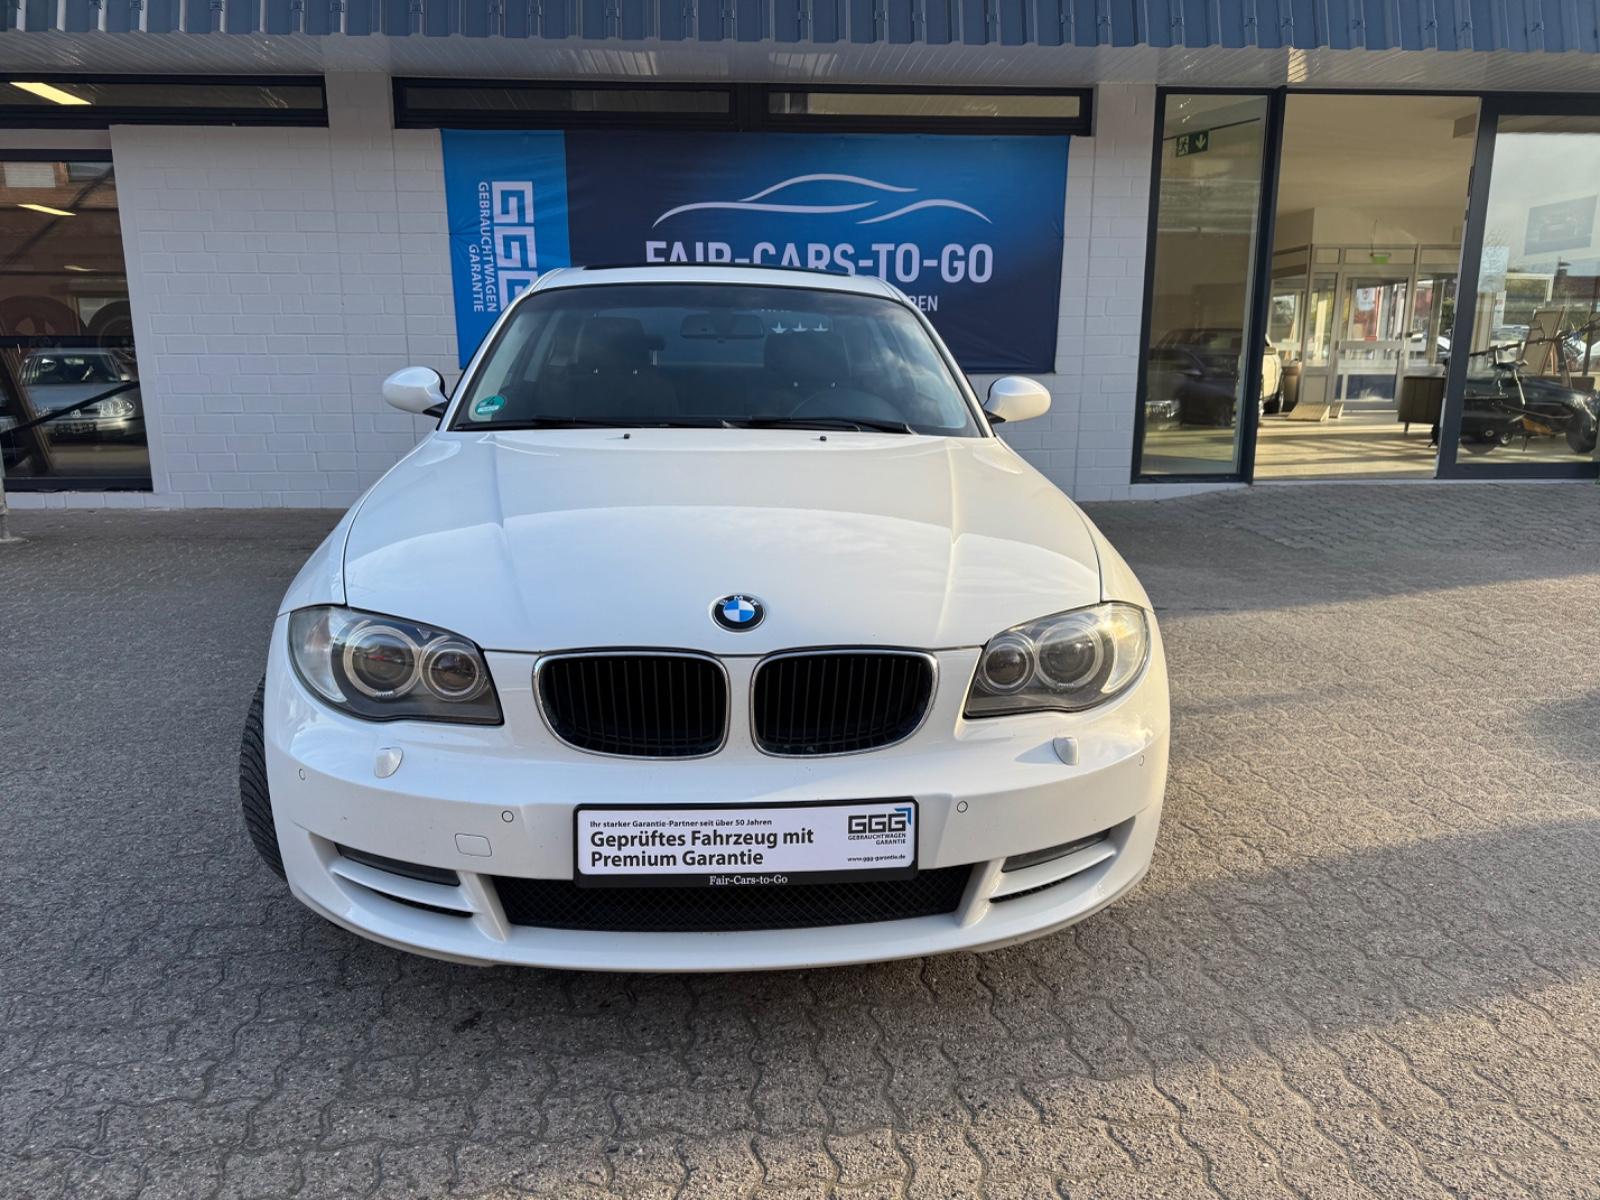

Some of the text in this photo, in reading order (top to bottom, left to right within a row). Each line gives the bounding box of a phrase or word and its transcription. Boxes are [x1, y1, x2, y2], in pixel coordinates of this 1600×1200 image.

[478, 182, 498, 312] GEBRAUCHTWAGEN
[646, 241, 994, 283] FAIR-CARS-TO-GO
[468, 244, 485, 312] GARANTIE
[590, 818, 773, 828] Ihr starker Garantie-Partner seit über 50 Jahren
[848, 813, 907, 834] GGG
[590, 827, 814, 851] Geprüftes Fahrzeug mit
[875, 838, 907, 846] GARANTIE
[591, 849, 764, 867] Premium Garantie
[709, 874, 788, 885] Fair-Cars-to-Go
